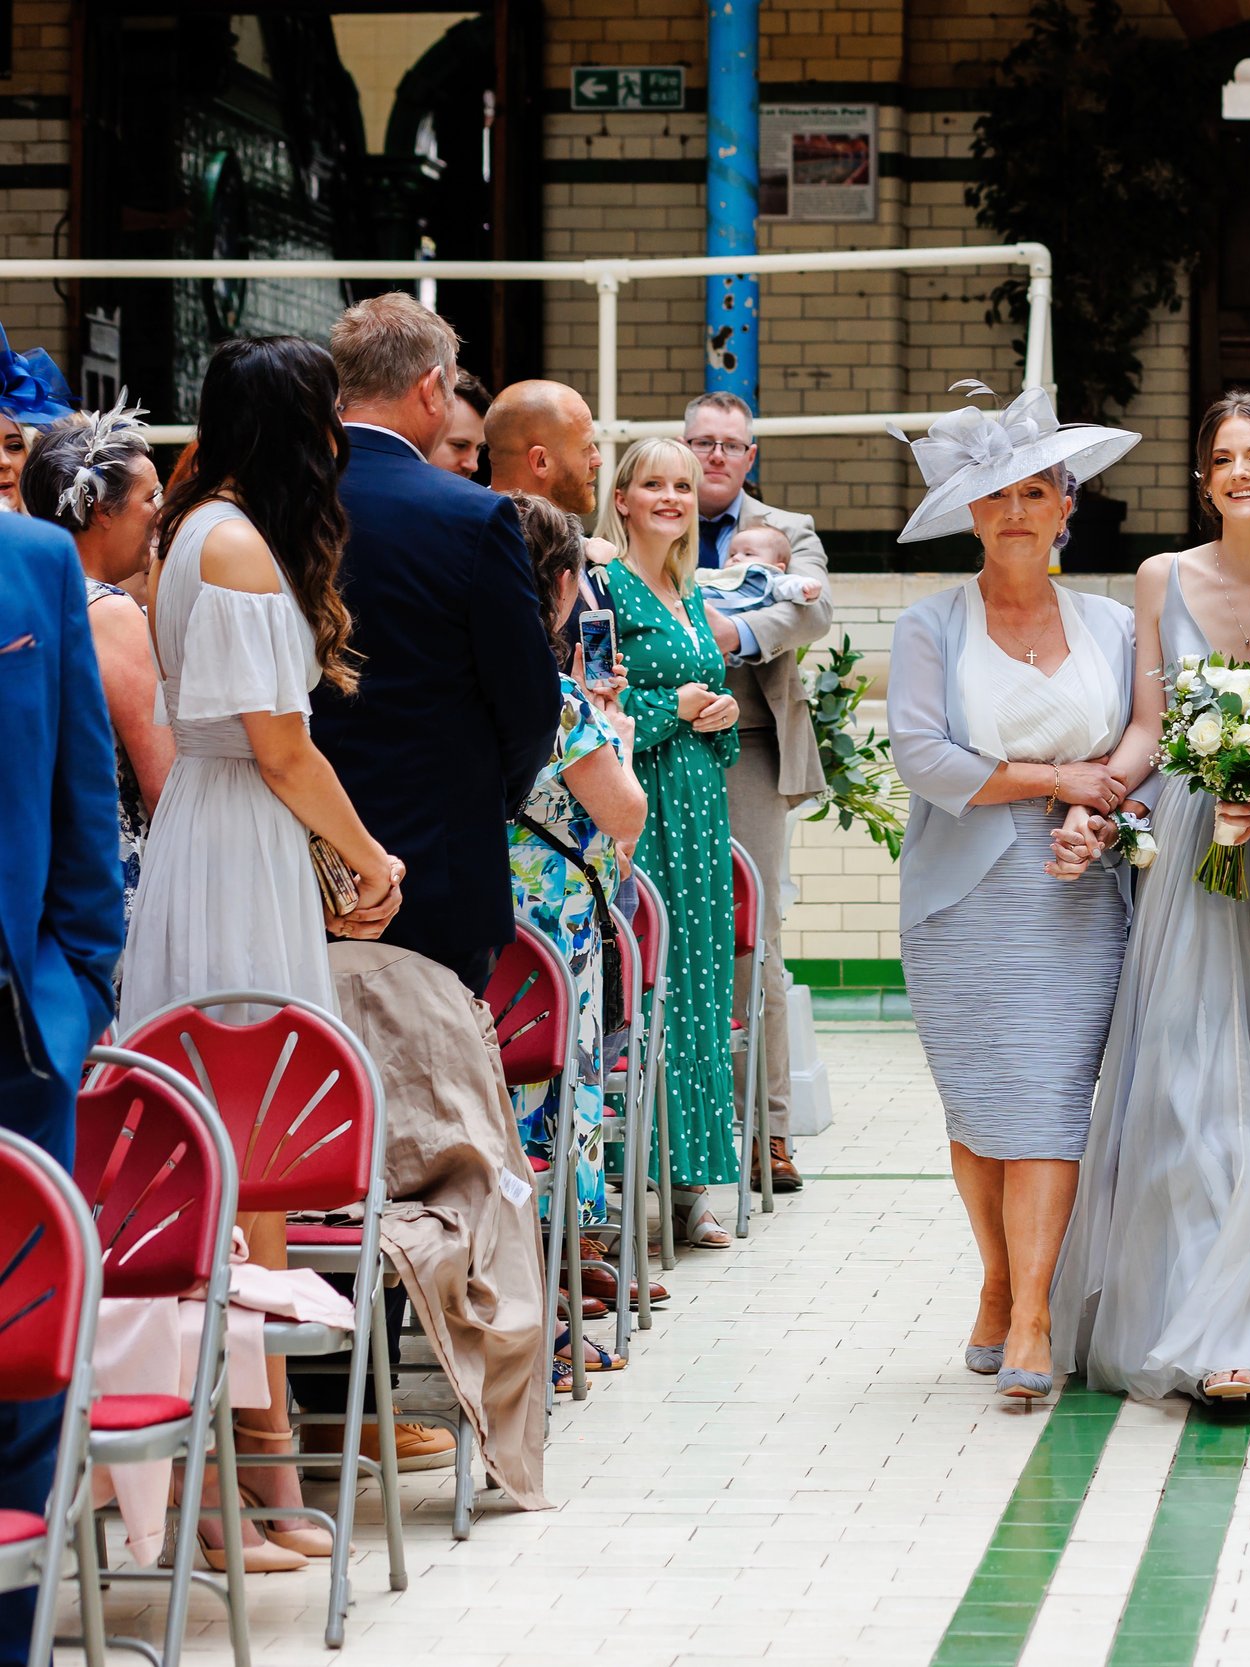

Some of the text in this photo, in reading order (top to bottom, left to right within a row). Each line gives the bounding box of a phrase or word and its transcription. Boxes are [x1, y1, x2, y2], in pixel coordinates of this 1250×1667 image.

[649, 72, 679, 86] Fire
[650, 90, 679, 101] exit
[840, 106, 867, 116] Pool
